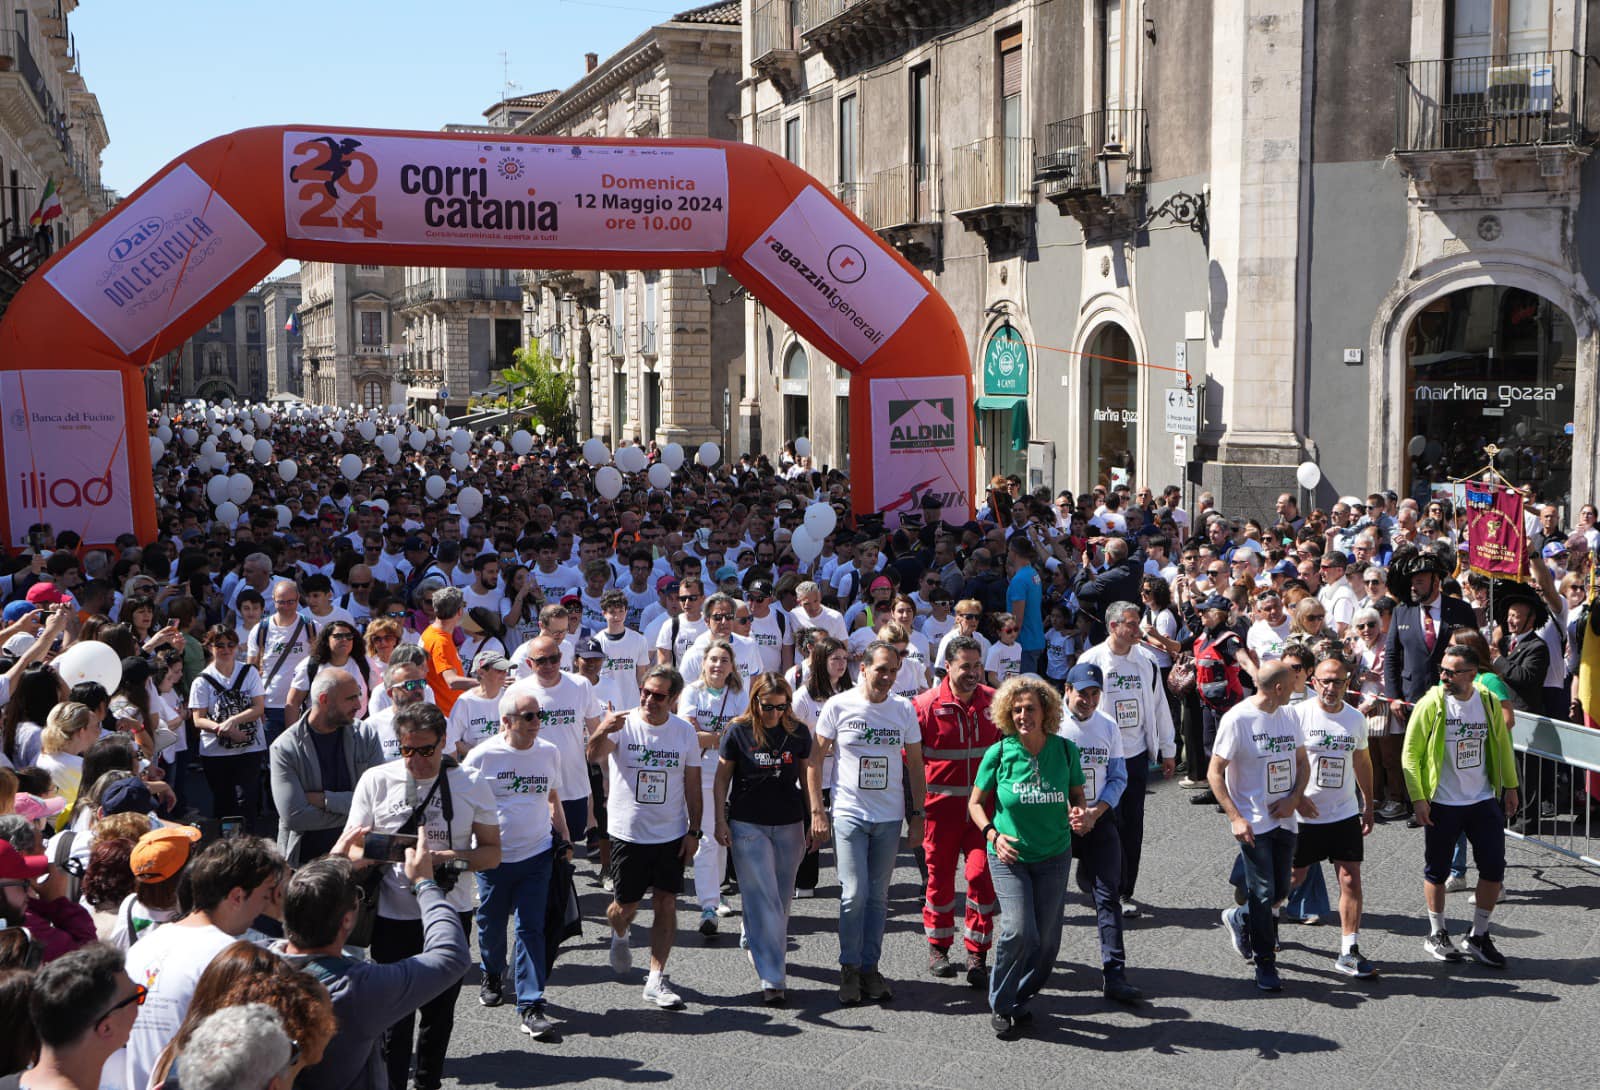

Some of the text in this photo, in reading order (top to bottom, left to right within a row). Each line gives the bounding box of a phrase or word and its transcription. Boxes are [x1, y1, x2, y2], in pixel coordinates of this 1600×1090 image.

[401, 158, 487, 197] corri
[602, 174, 696, 191] Domenica
[425, 189, 558, 231] catania
[575, 193, 723, 214] 12 Maggio 2024
[605, 216, 692, 231] ore 10.00
[112, 220, 160, 260] Dais
[540, 233, 558, 241] tutti
[104, 217, 213, 307] DOLCESICILIA
[839, 256, 855, 269] r
[765, 235, 885, 345] ragazzinigenerali
[988, 335, 1024, 376] FARMACIA
[1415, 382, 1556, 407] martina gozza
[32, 413, 115, 422] Banca del Fucino
[1122, 409, 1138, 428] gozz
[890, 424, 955, 441] ALDINI
[20, 469, 113, 509] iliad
[550, 708, 575, 717] catania
[848, 720, 867, 730] corri
[651, 749, 680, 759] catania
[497, 770, 516, 780] corri
[522, 775, 549, 784] catania
[647, 785, 657, 793] 21
[1012, 781, 1041, 794] corri
[1020, 787, 1065, 804] catania
